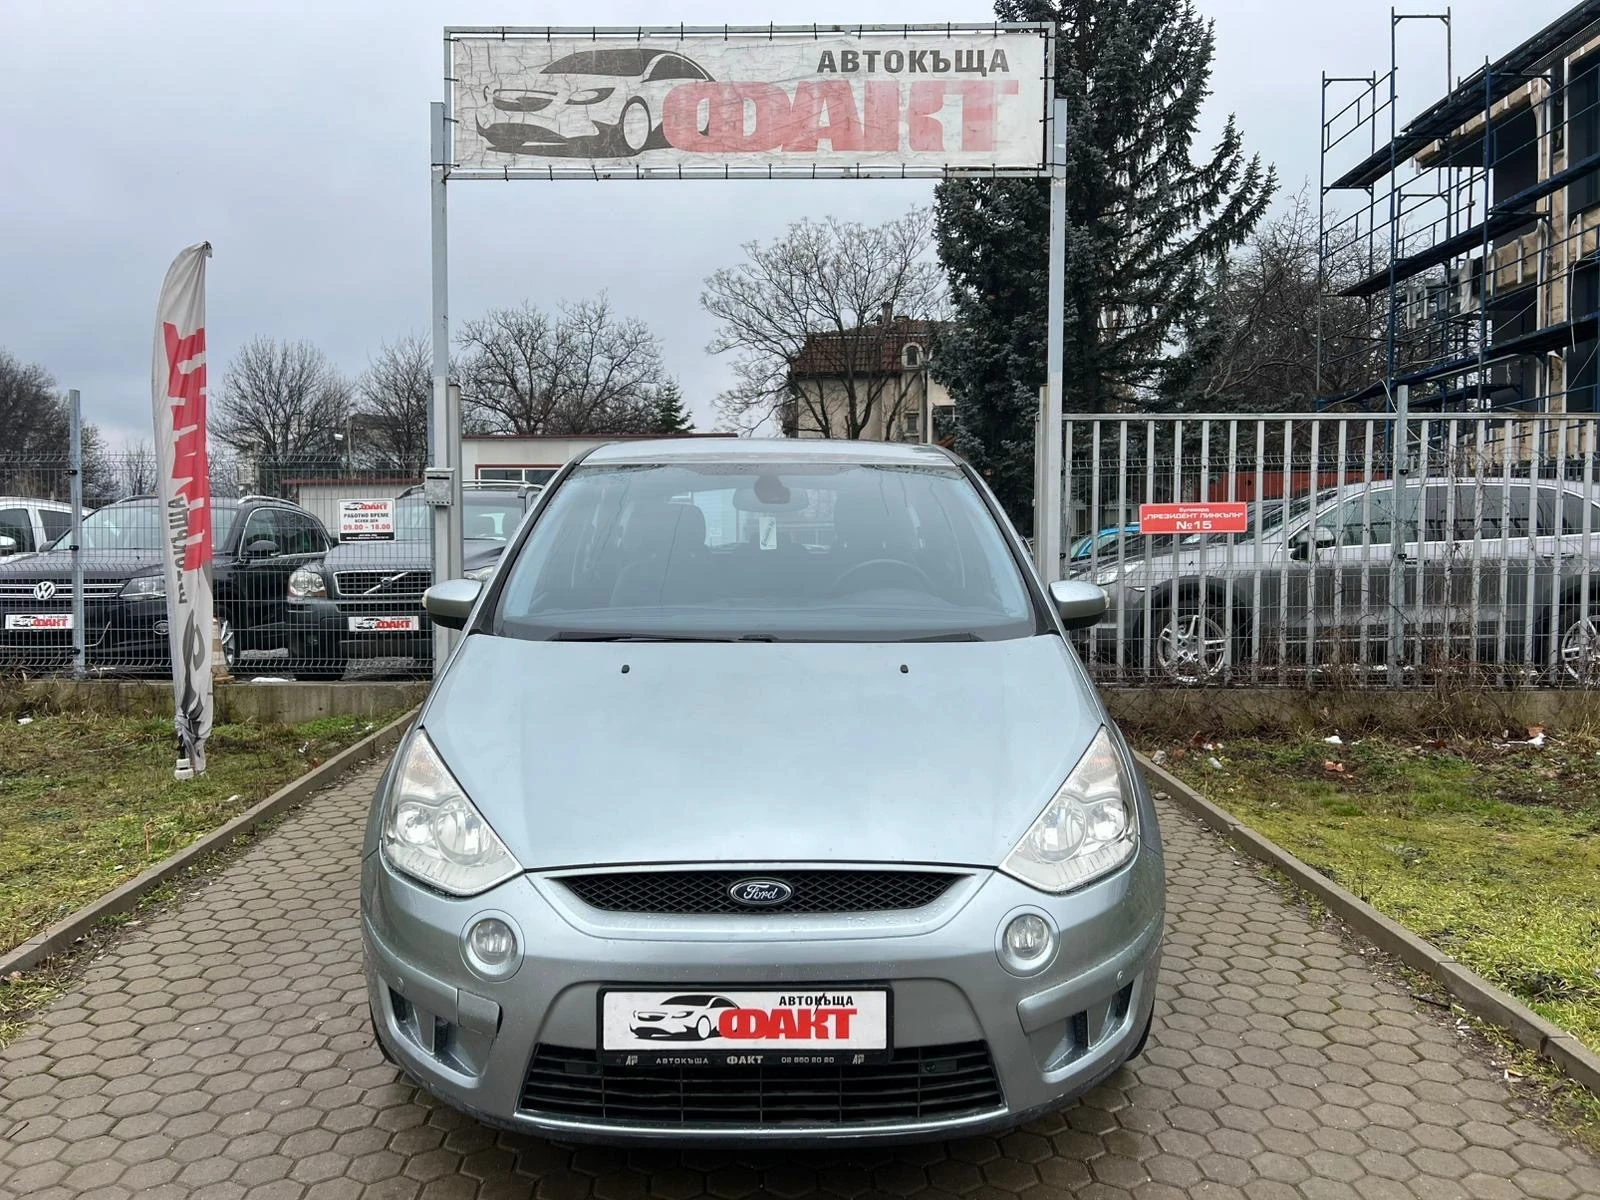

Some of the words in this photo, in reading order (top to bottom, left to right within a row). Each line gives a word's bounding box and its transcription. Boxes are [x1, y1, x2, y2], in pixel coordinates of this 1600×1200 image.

[817, 49, 1010, 77] АВТОКЪЩА
[662, 80, 1019, 152] ФАКТ
[743, 884, 778, 900] Ford
[778, 995, 854, 1008] АВТОКЪЩА
[718, 1008, 857, 1040] ФАКТ
[726, 1055, 763, 1064] ФАКТ
